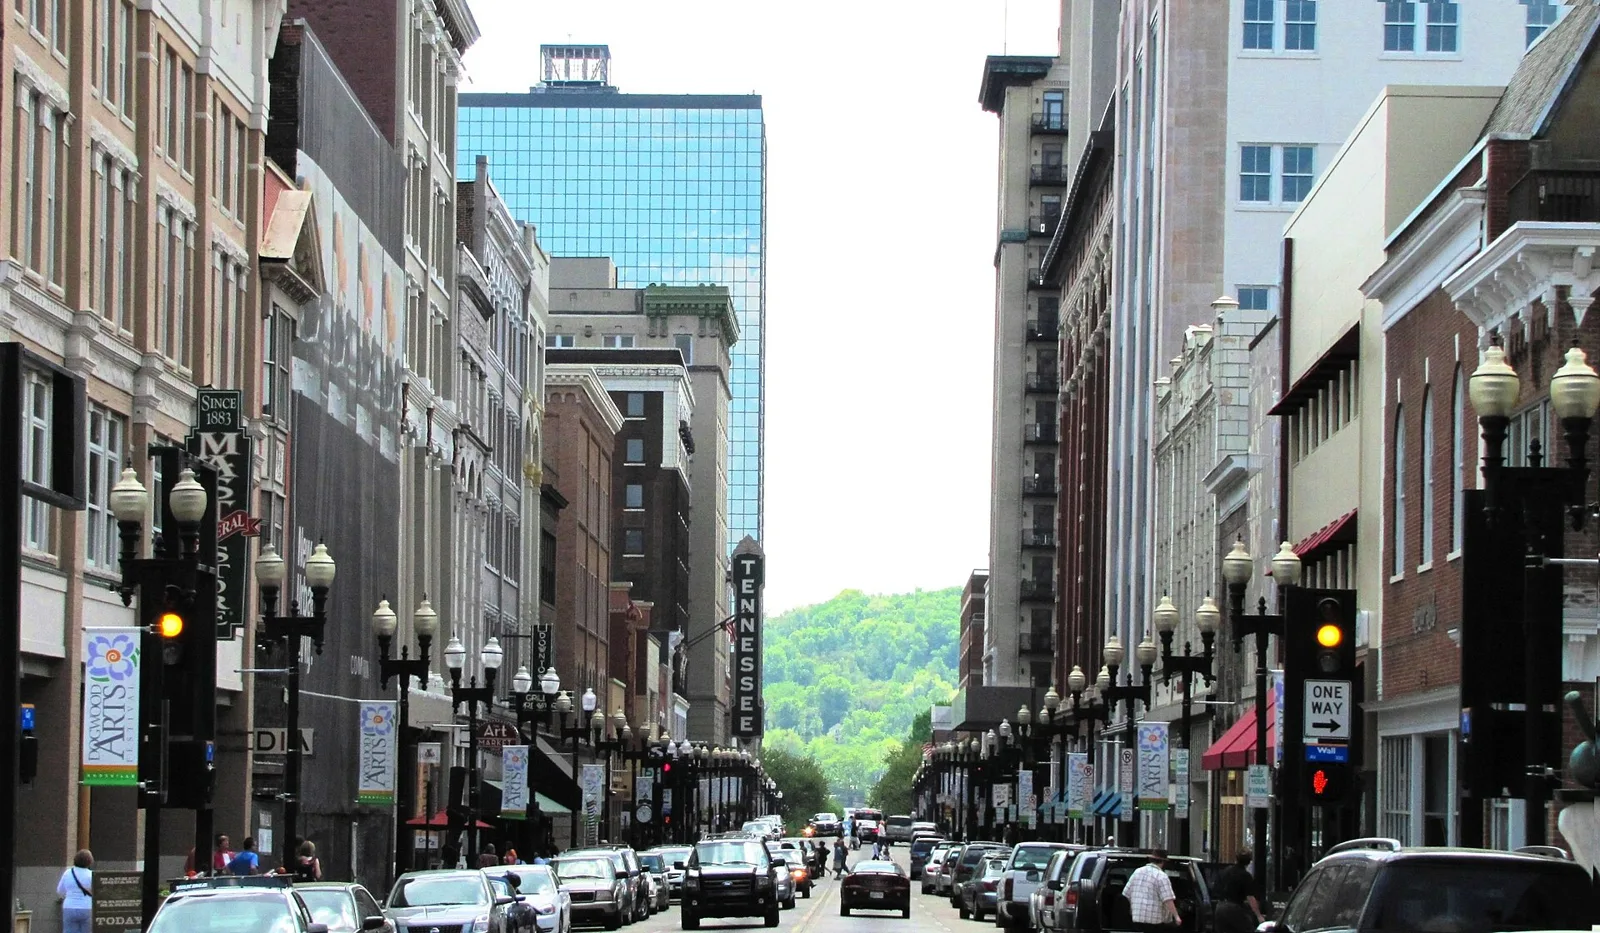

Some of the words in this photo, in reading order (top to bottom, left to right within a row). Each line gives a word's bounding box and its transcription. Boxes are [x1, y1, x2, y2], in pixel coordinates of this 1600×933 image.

[201, 395, 237, 411] SINCE
[206, 411, 231, 426] 1883
[740, 560, 756, 731] TENNESSEE
[1313, 686, 1342, 699] ONE
[1311, 702, 1343, 715] WAY
[88, 684, 101, 761] DOGWOOD
[94, 685, 126, 761] ARTS
[483, 724, 508, 737] Art
[1317, 746, 1336, 755] Wall
[366, 737, 386, 787] ARTS
[1144, 753, 1161, 795] ARTS
[506, 772, 521, 807] ARTS
[96, 916, 142, 926] TODAY
